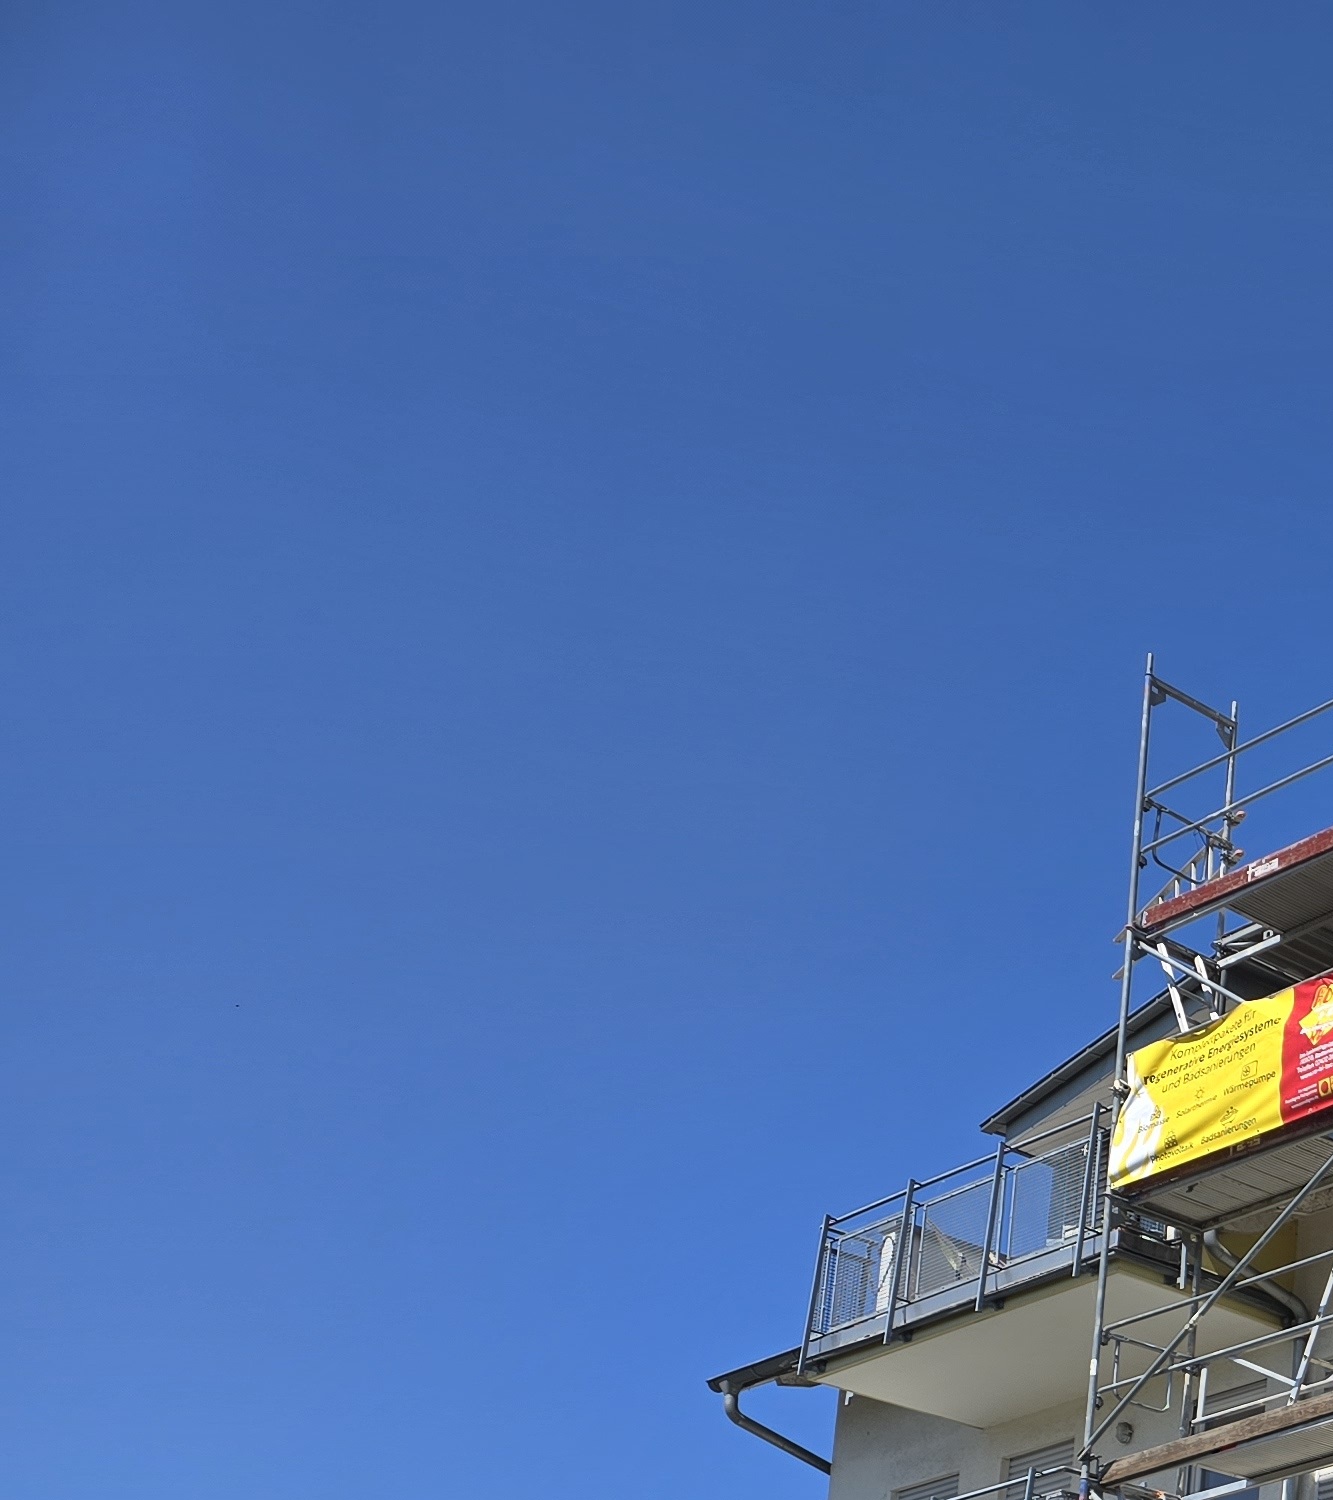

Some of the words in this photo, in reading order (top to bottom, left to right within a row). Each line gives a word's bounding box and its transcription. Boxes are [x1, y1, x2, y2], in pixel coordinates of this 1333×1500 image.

[1244, 1009, 1257, 1022] für
[1143, 1053, 1205, 1086] regenerative
[1207, 1018, 1281, 1059] Energiesysteme
[1161, 1078, 1181, 1093] und
[1182, 1042, 1256, 1084] Badsanierungen
[1137, 1116, 1170, 1134] Biomasse
[1176, 1094, 1217, 1119] Solarthermie
[1223, 1071, 1276, 1096] Wärmepumpe
[1150, 1143, 1194, 1164] Photovoltaik
[1201, 1117, 1257, 1145] Badsanierungen
